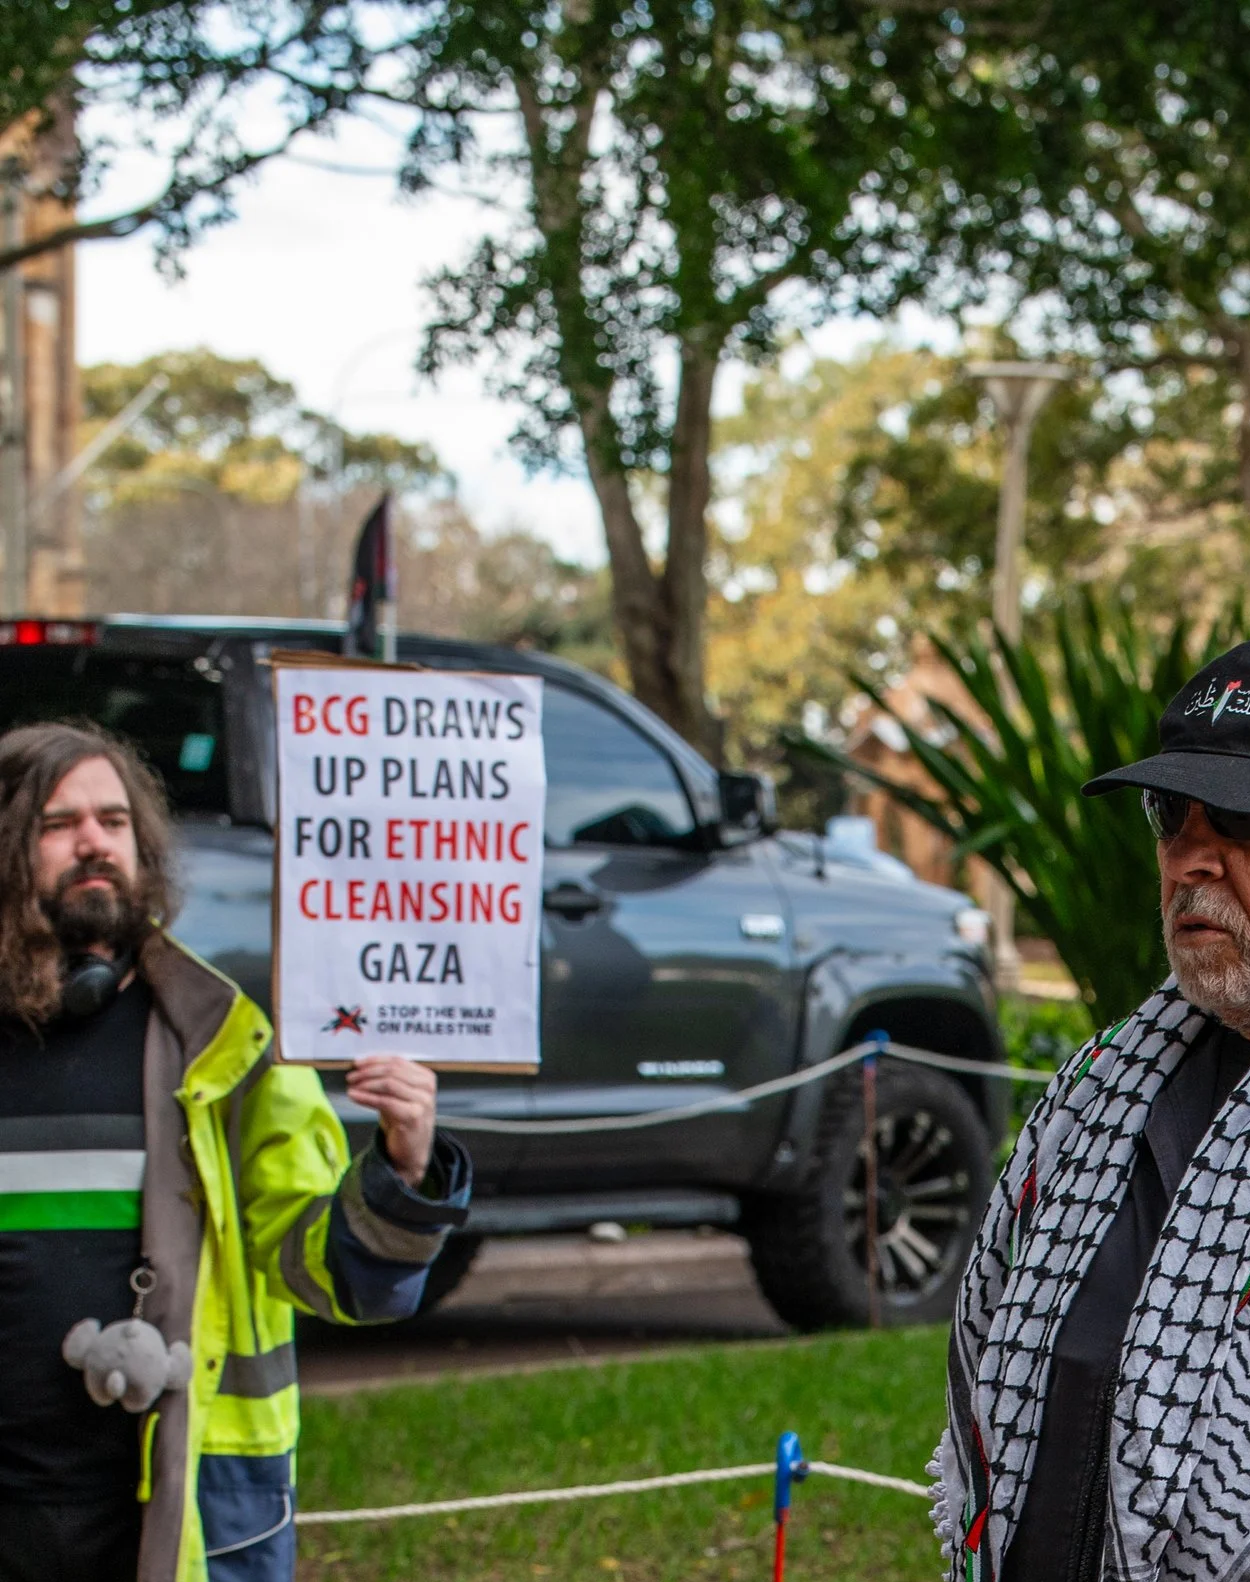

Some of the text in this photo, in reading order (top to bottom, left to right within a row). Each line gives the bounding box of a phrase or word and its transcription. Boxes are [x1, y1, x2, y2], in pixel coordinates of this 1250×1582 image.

[292, 694, 525, 740] BCG DRAWS
[314, 756, 510, 800] UP PLANS
[295, 816, 530, 863] FOR ETHNIC
[299, 879, 522, 924] CLEANSING
[359, 942, 464, 984] GAZA
[376, 1021, 493, 1036] ON PALESTINE
[377, 1005, 496, 1019] STOP THE WAR
